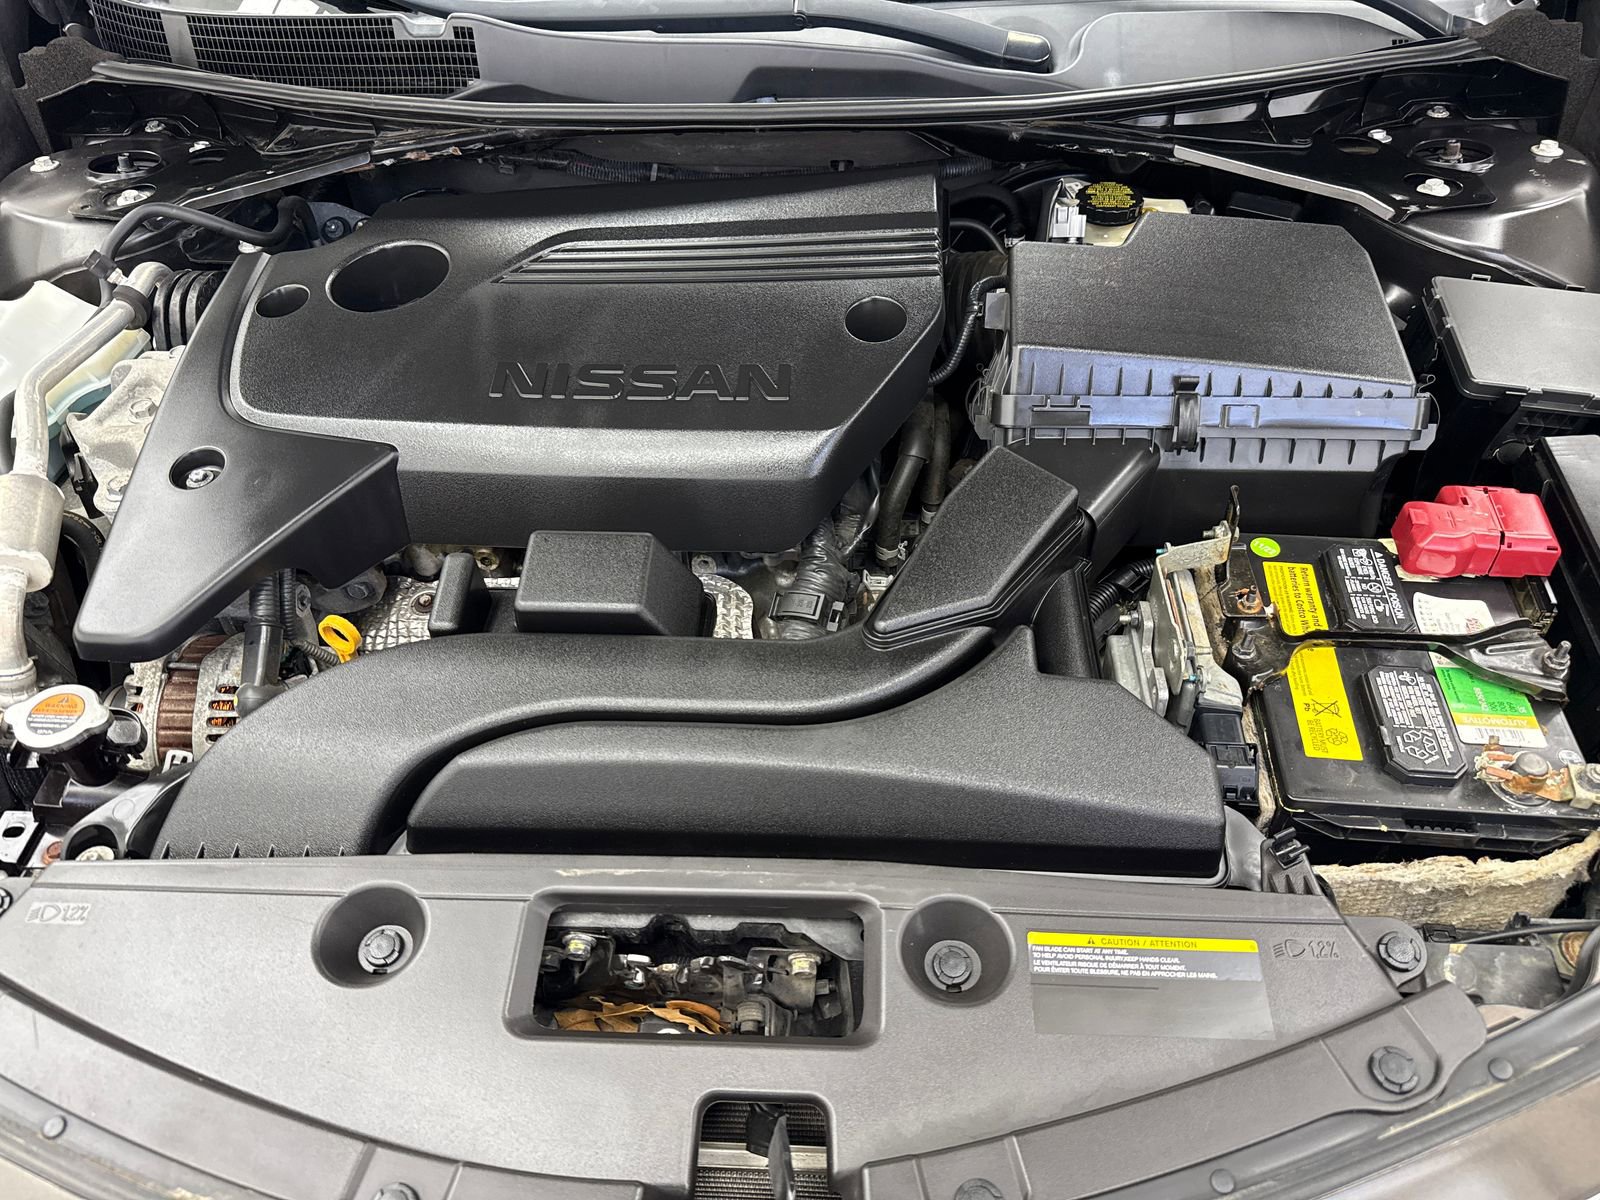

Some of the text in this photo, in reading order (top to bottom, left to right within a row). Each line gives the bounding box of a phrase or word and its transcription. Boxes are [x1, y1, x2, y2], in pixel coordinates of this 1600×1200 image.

[488, 362, 792, 400] NISSAN
[1288, 566, 1300, 592] batteries
[1296, 600, 1306, 618] Costco
[1300, 567, 1310, 586] Return
[1305, 588, 1318, 613] warranty
[1312, 614, 1323, 627] and
[1377, 558, 1394, 586] DANGER
[1388, 592, 1406, 619] POISON
[1304, 702, 1310, 712] Pb
[1464, 716, 1527, 726] AUTOMOTIVE
[1309, 726, 1320, 751] RECYCLED
[1314, 718, 1328, 753] BATTERY MUST
[1100, 938, 1140, 947] CAUTION
[1149, 940, 1197, 948] ATTENTION
